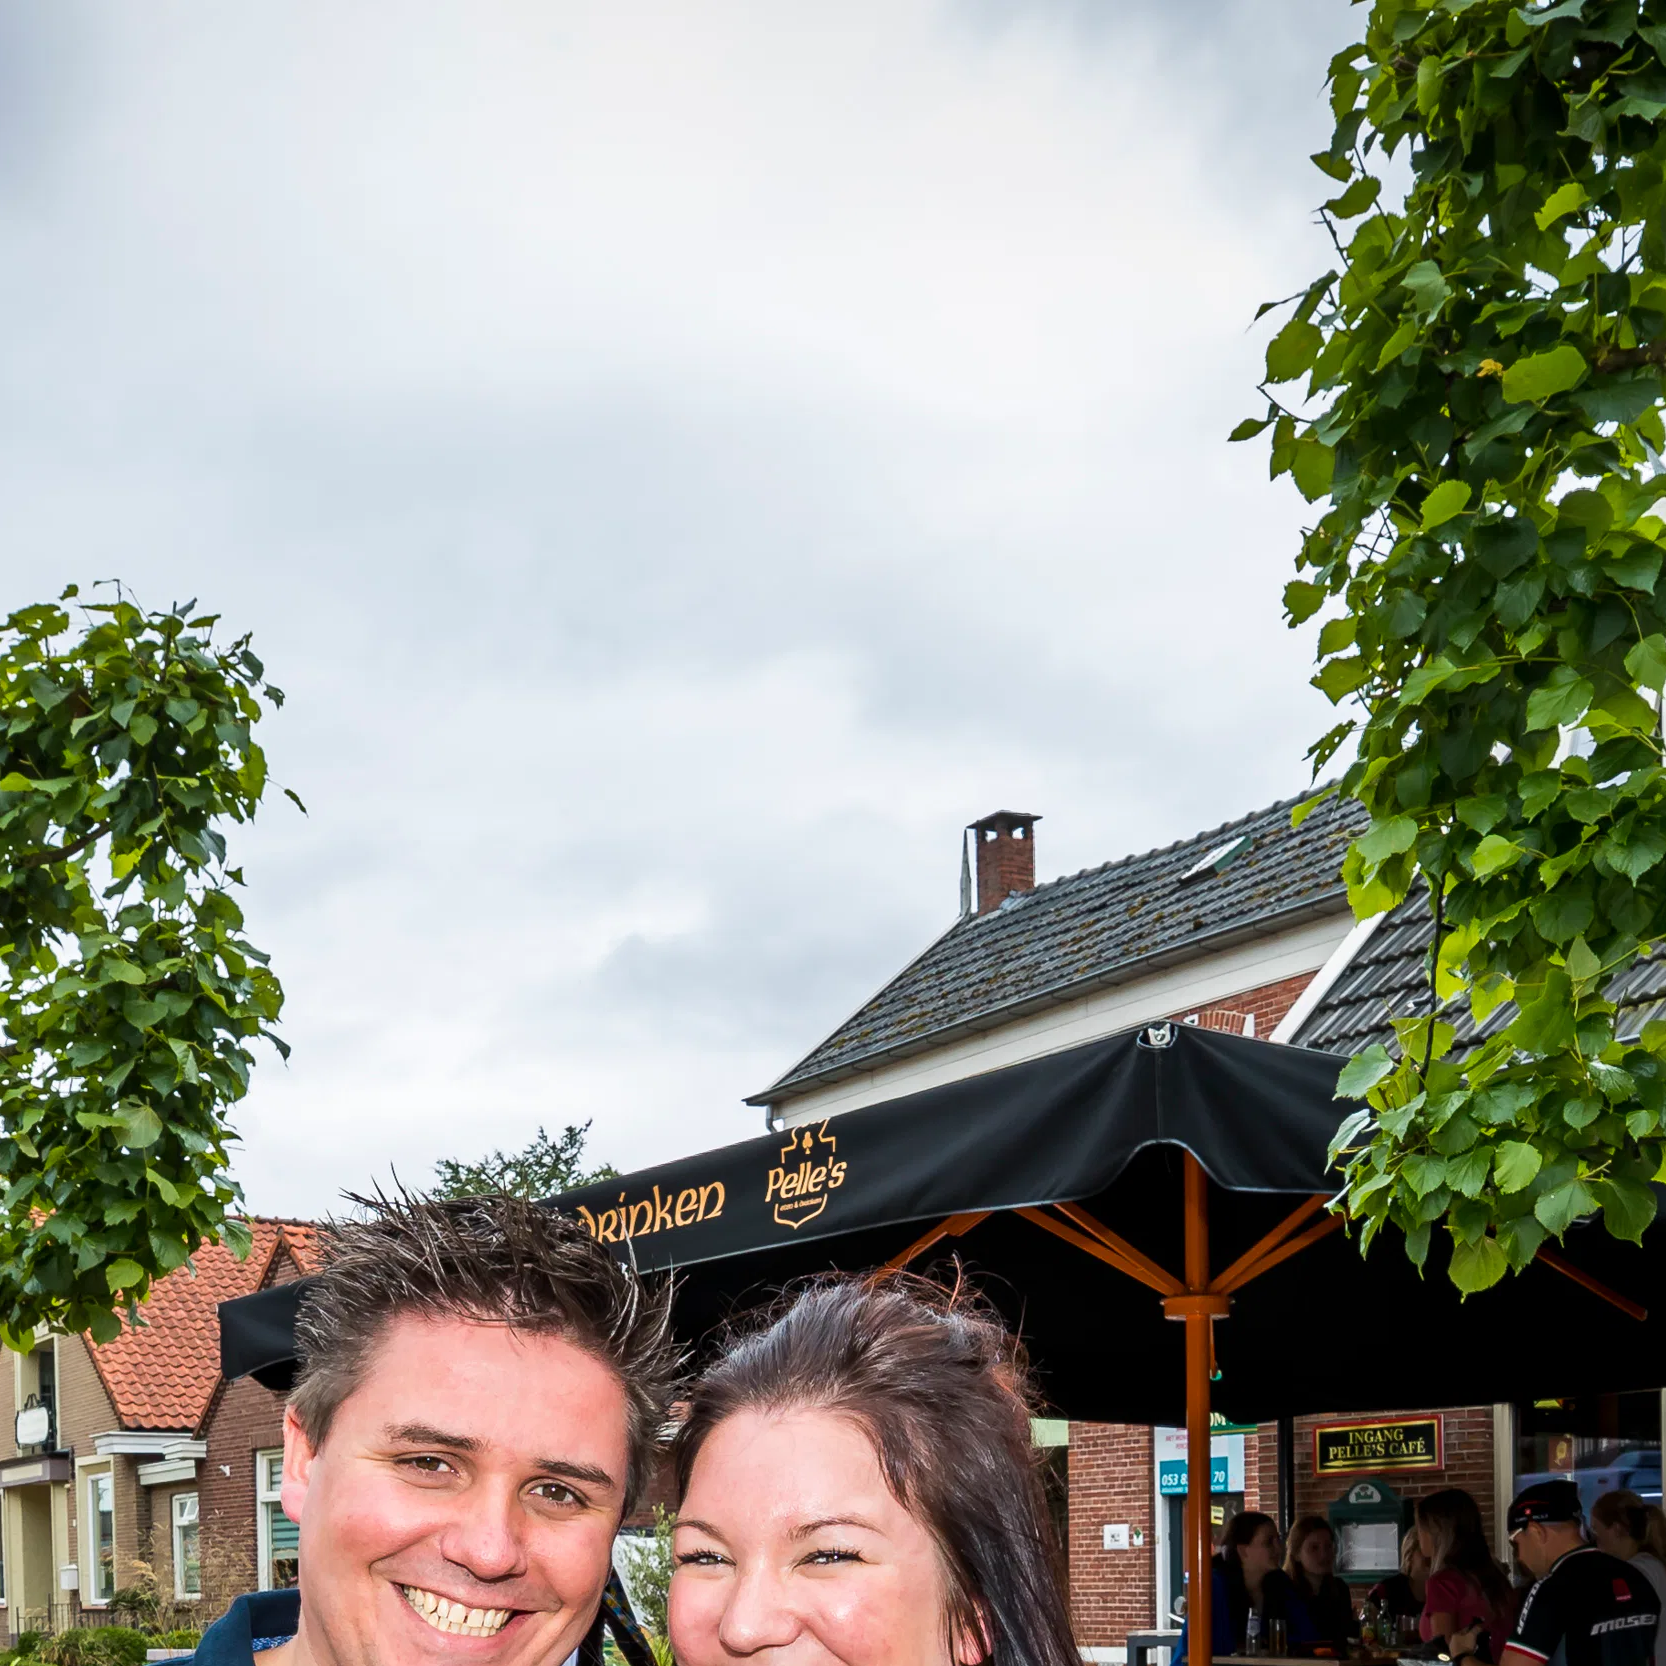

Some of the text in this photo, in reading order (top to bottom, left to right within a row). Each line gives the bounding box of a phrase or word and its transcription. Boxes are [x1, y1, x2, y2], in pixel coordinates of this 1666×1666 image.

[765, 1156, 847, 1202] Pelle's
[1349, 1428, 1404, 1444] INGANG
[1329, 1437, 1426, 1460] PELLE'S CAFÉ
[1161, 1473, 1179, 1486] 053
